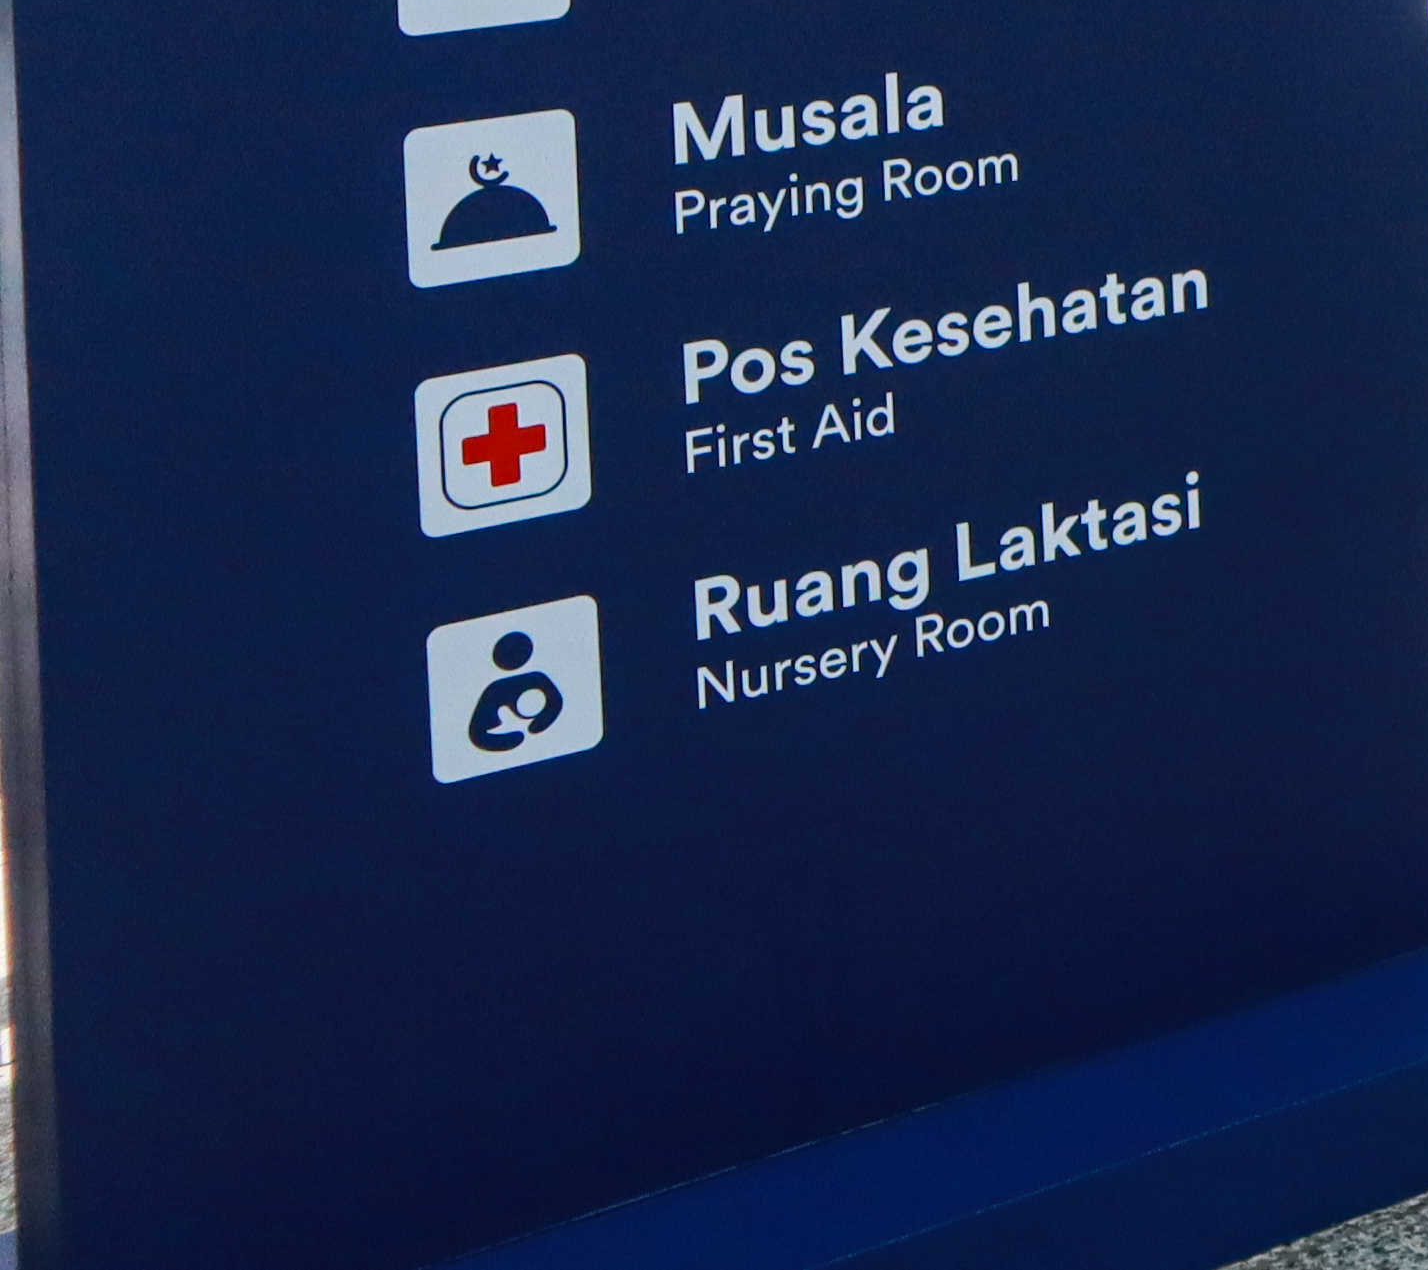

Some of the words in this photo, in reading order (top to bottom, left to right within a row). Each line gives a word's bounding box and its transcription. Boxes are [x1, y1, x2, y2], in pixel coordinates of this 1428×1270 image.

[672, 72, 945, 166] Musala
[675, 173, 863, 234] Praying
[883, 154, 1018, 201] Room
[684, 340, 814, 404] Pos
[841, 270, 1207, 375] Kesehatan
[686, 417, 795, 473] First
[813, 392, 894, 448] Aid
[694, 548, 929, 640] Ruang
[956, 471, 1200, 581] Laktasi
[697, 635, 897, 709] Nursery
[916, 594, 1050, 658] Room
